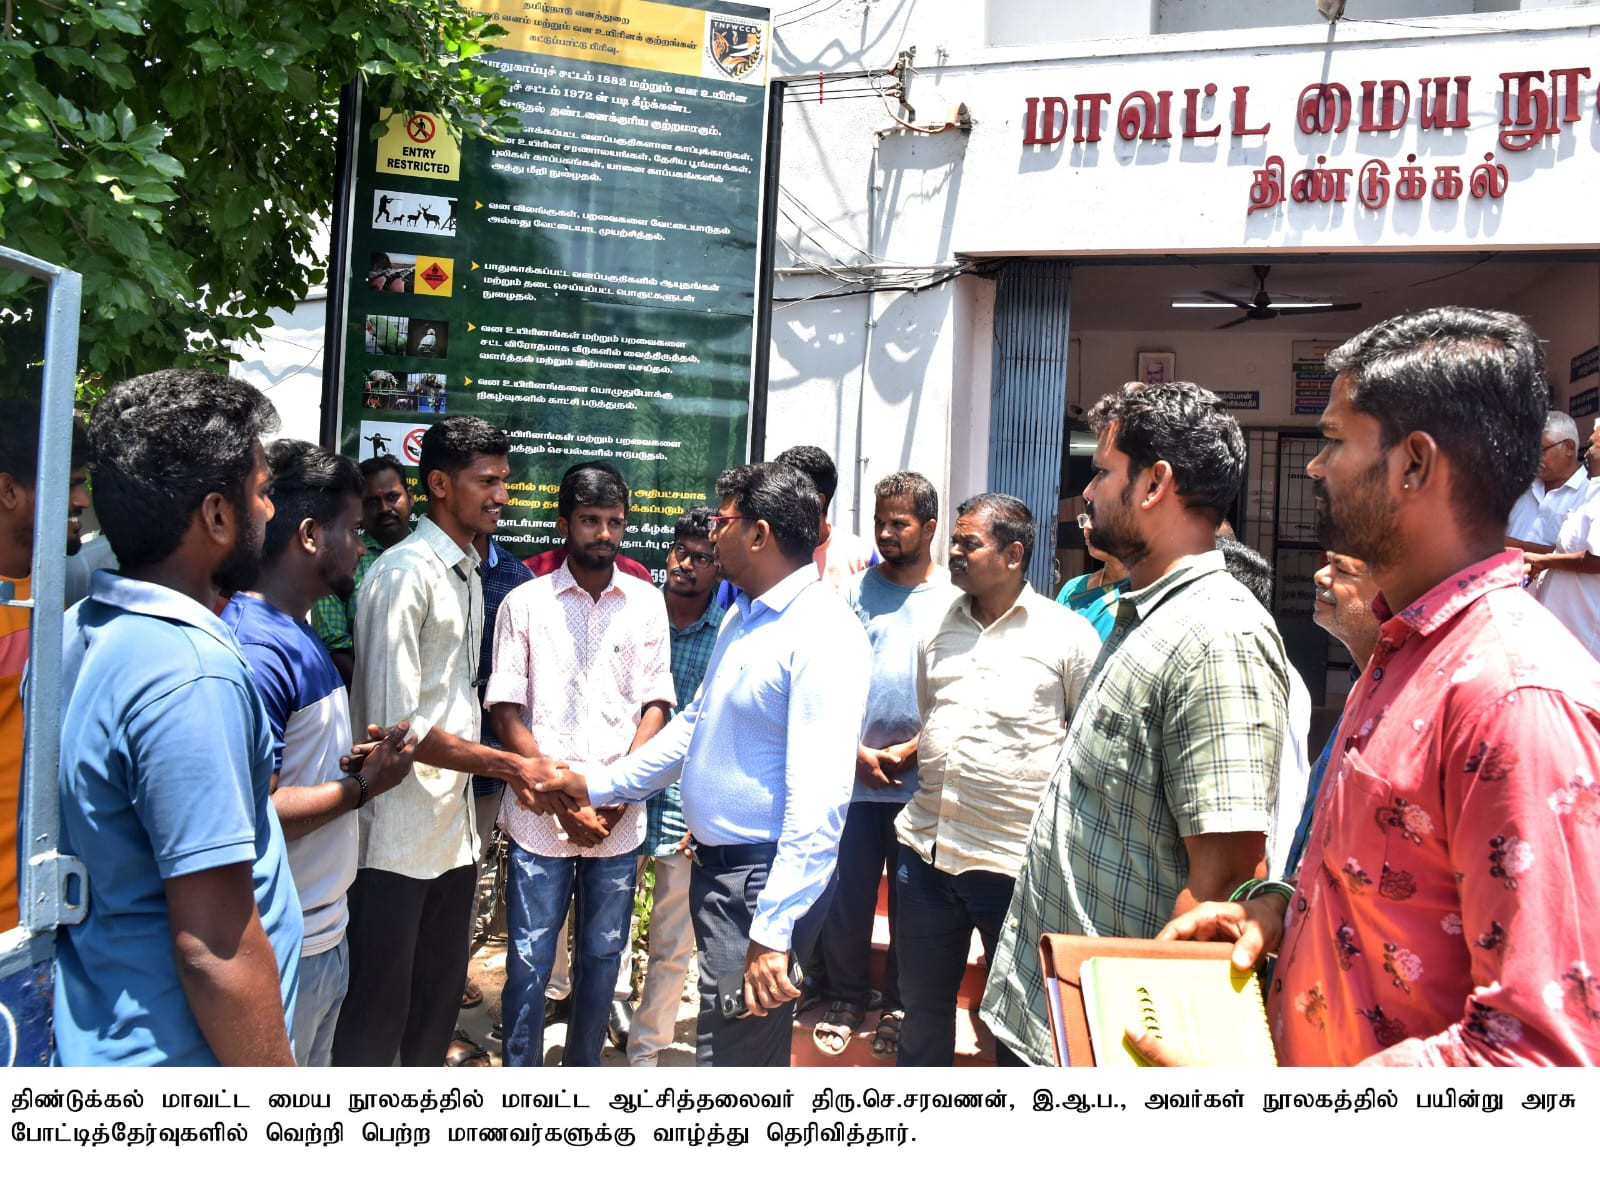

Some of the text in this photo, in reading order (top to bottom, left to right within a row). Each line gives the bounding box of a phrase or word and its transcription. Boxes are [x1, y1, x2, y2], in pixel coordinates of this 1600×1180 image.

[534, 18, 571, 30] மற்றும்
[559, 70, 594, 82] சட்டம்
[597, 74, 627, 87] 1882
[629, 79, 672, 93] மற்றும்
[675, 87, 698, 96] வன
[525, 84, 561, 96] சட்டம்
[564, 88, 593, 101] 1972
[1022, 82, 1271, 145] மாவட்ட
[1296, 74, 1472, 136] மைய
[402, 146, 436, 159] ENTRY
[387, 158, 450, 174] RESTRICTED
[1247, 151, 1509, 216] திண்டுக்கல்
[488, 202, 511, 211] வன
[487, 216, 531, 228] அல்லது
[483, 276, 522, 287] மற்றும்
[523, 280, 551, 289] தடை
[480, 325, 503, 333] வன
[582, 332, 619, 344] மற்றும்
[536, 356, 574, 367] மற்றும்
[477, 378, 500, 387] வன
[576, 435, 614, 445] மற்றும்
